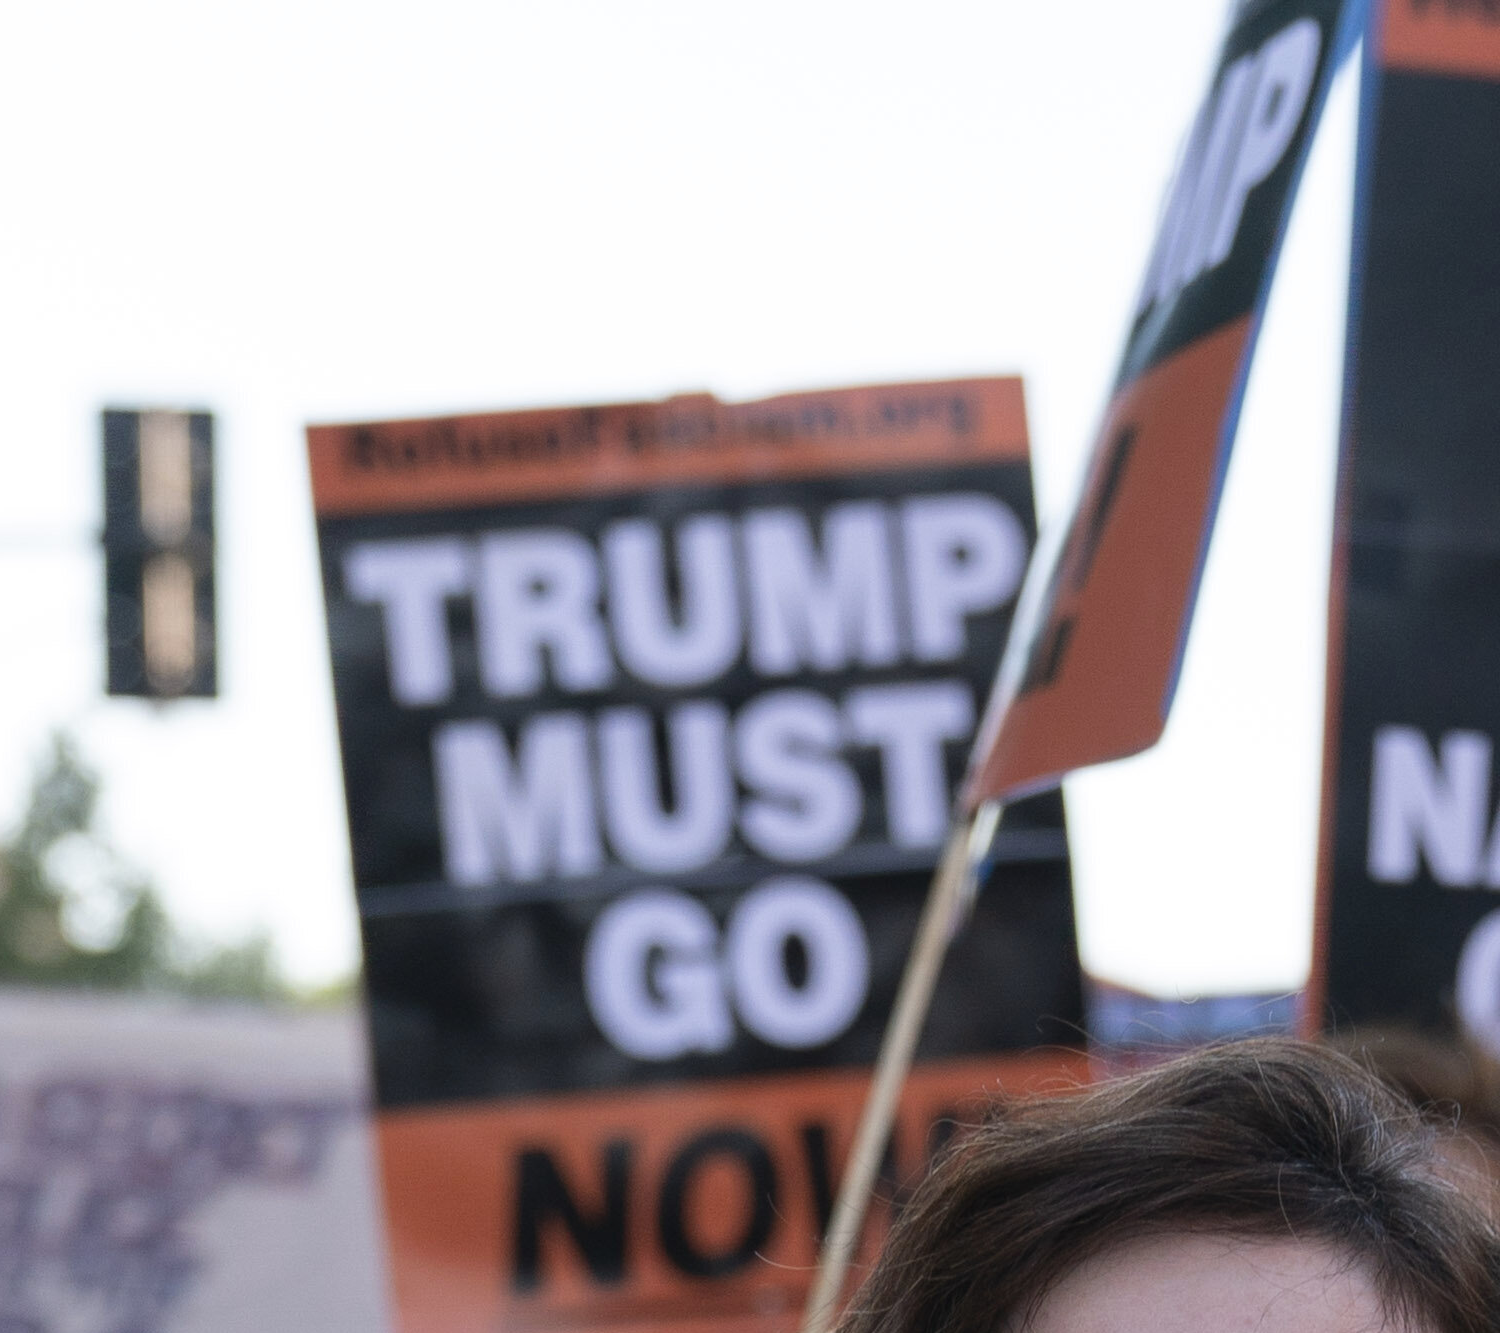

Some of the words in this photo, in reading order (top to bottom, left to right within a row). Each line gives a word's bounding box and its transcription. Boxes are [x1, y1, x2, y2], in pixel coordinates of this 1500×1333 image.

[342, 491, 1028, 707] TRUMP
[432, 680, 976, 887] MUST
[585, 875, 869, 1062] GO
